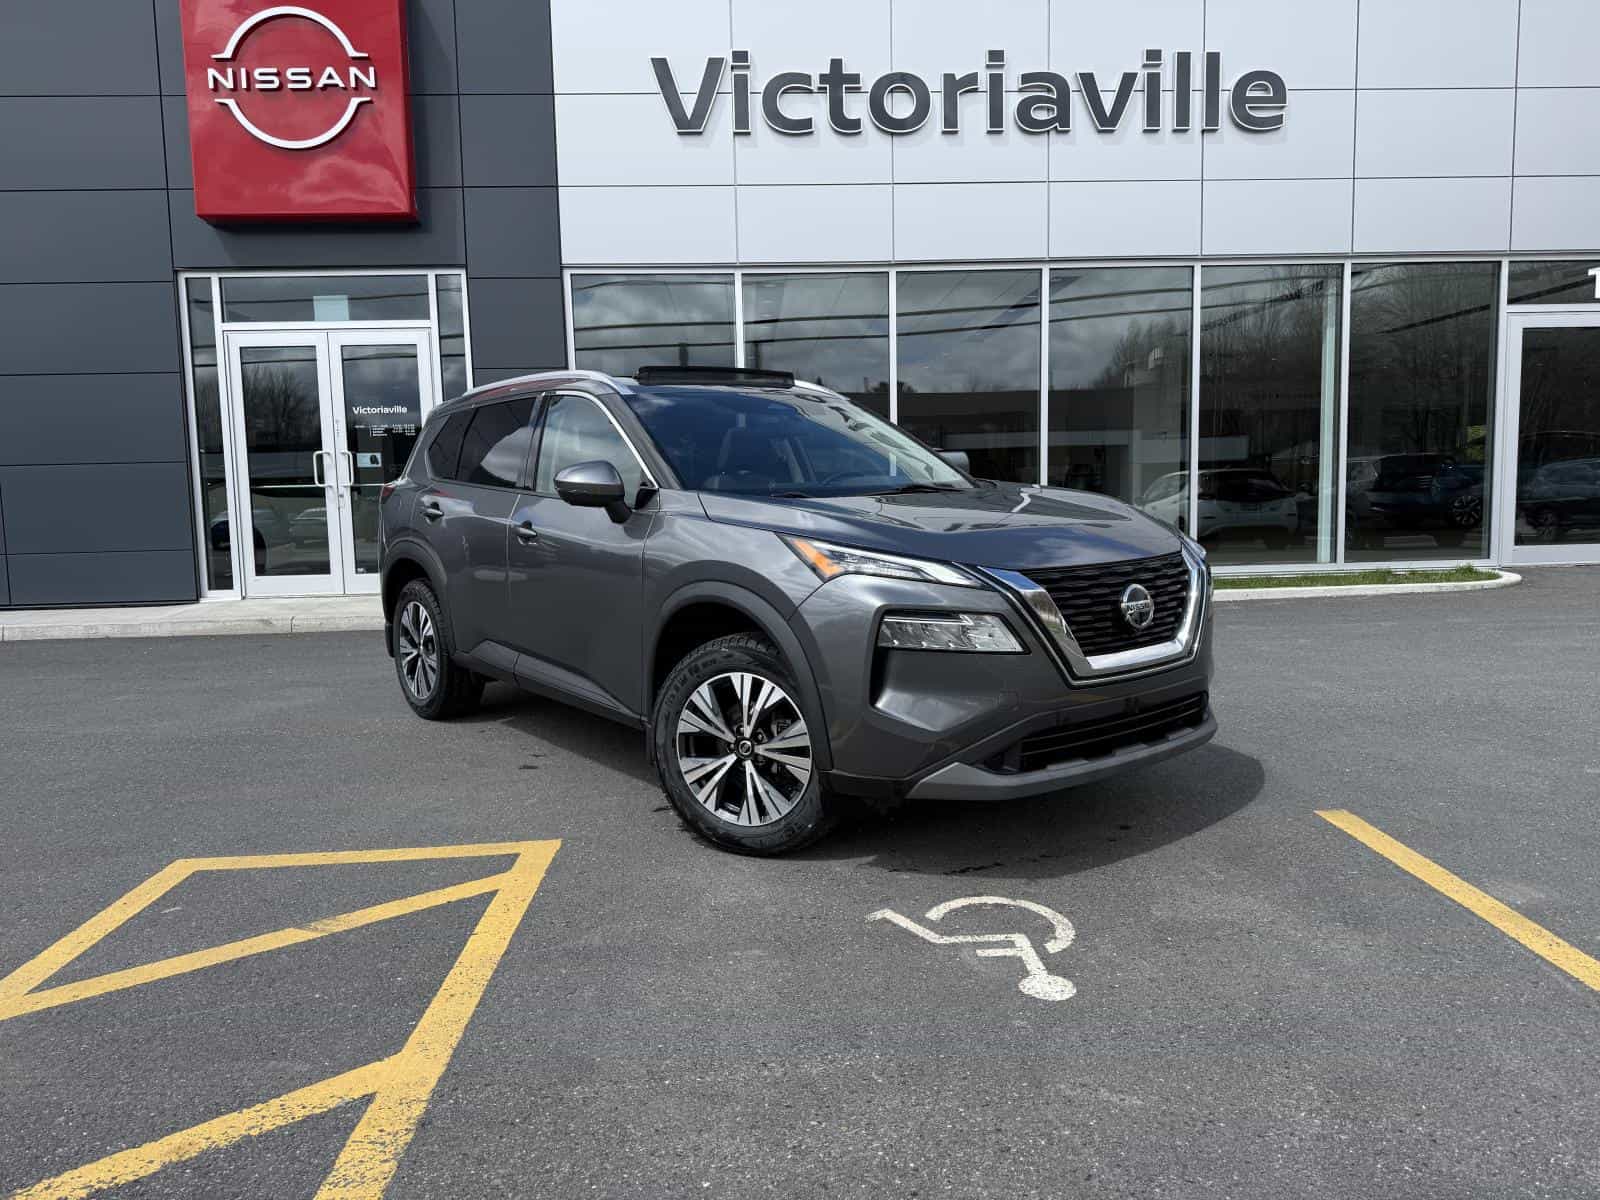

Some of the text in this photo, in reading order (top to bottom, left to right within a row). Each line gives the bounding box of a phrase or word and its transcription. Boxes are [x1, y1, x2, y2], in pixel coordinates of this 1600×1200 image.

[207, 66, 376, 89] NISSAN
[651, 49, 1288, 135] Victoriaville
[352, 405, 408, 414] Victoriaville
